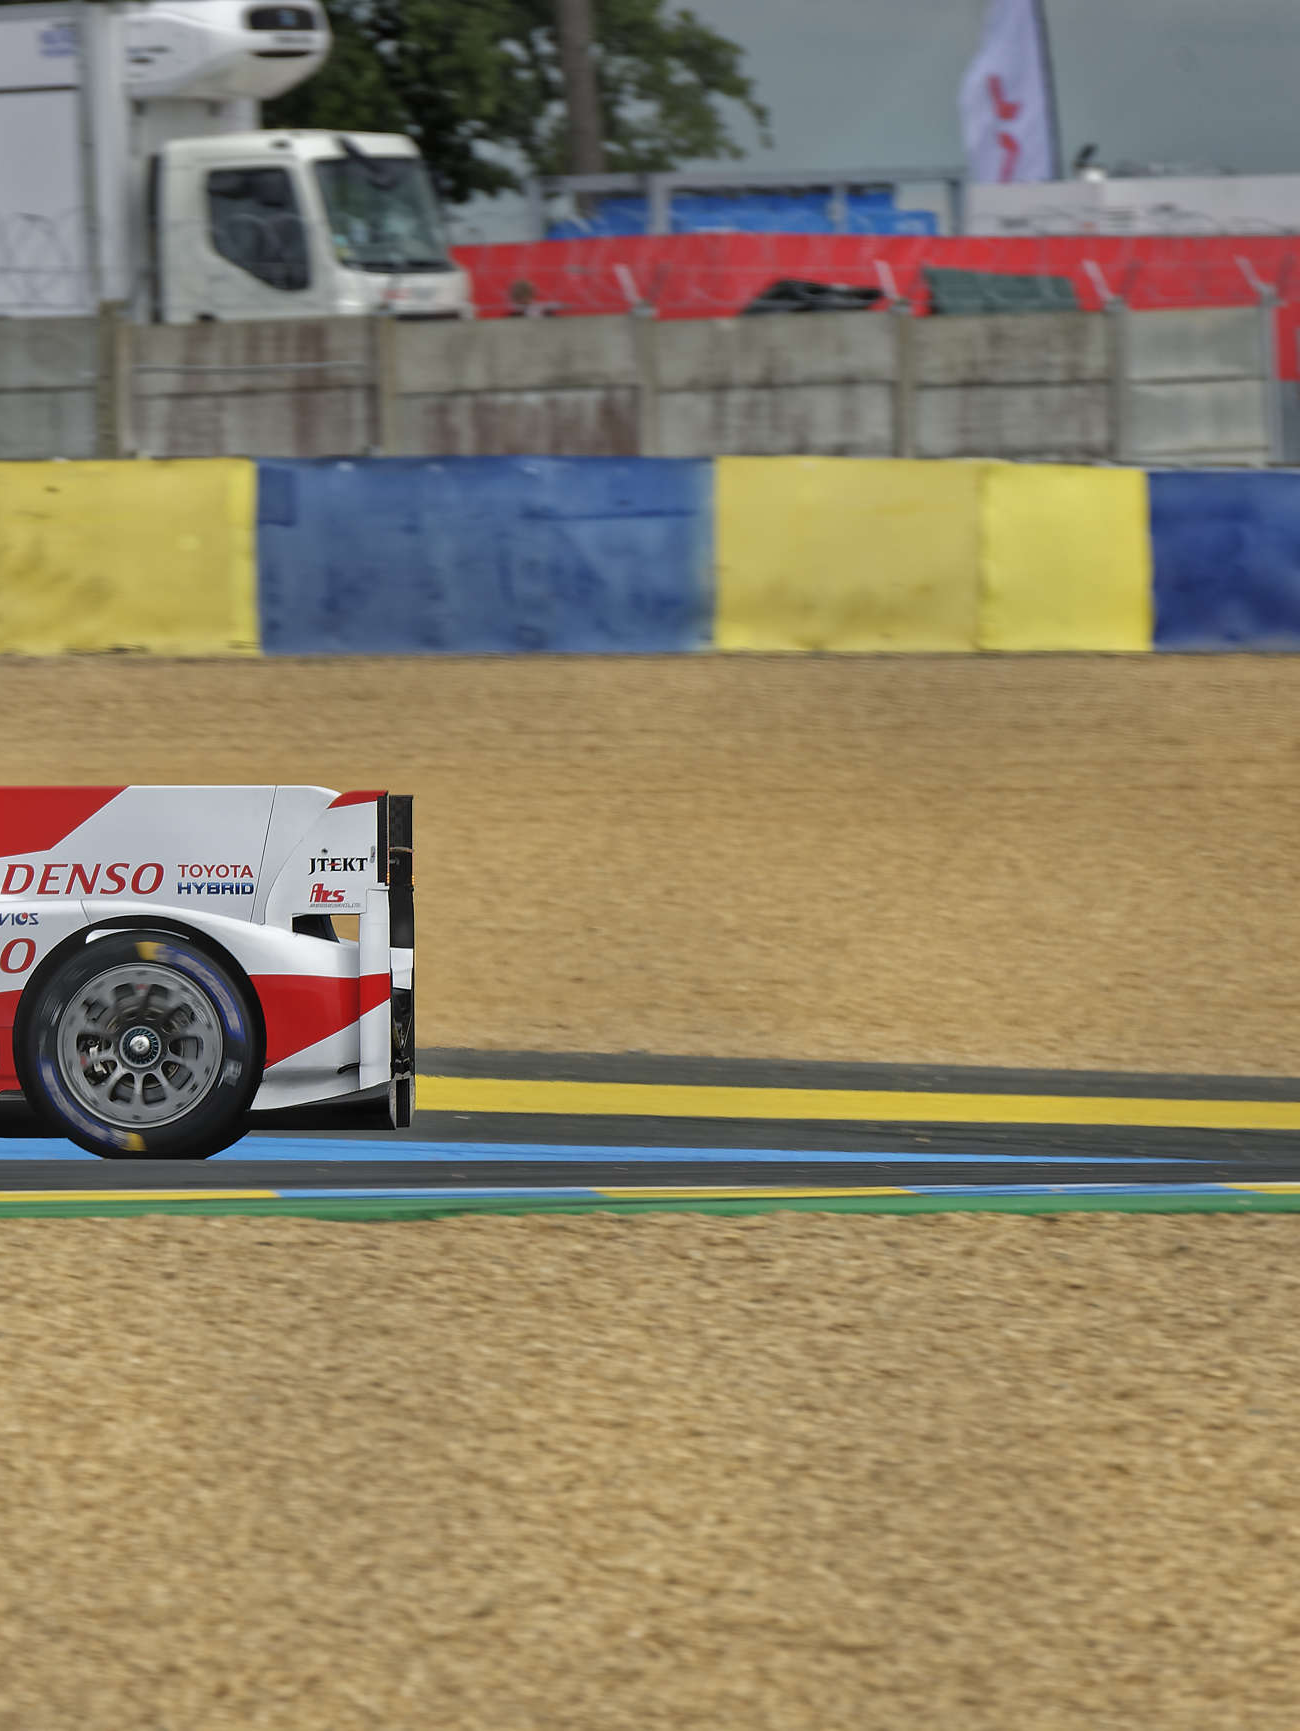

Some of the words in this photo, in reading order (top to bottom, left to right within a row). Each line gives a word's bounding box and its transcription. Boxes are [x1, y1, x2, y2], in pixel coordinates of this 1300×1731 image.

[177, 864, 254, 879] TOYOTA
[307, 857, 369, 876] JTEKT
[0, 862, 165, 895] DENSO
[177, 882, 255, 896] HYBRID
